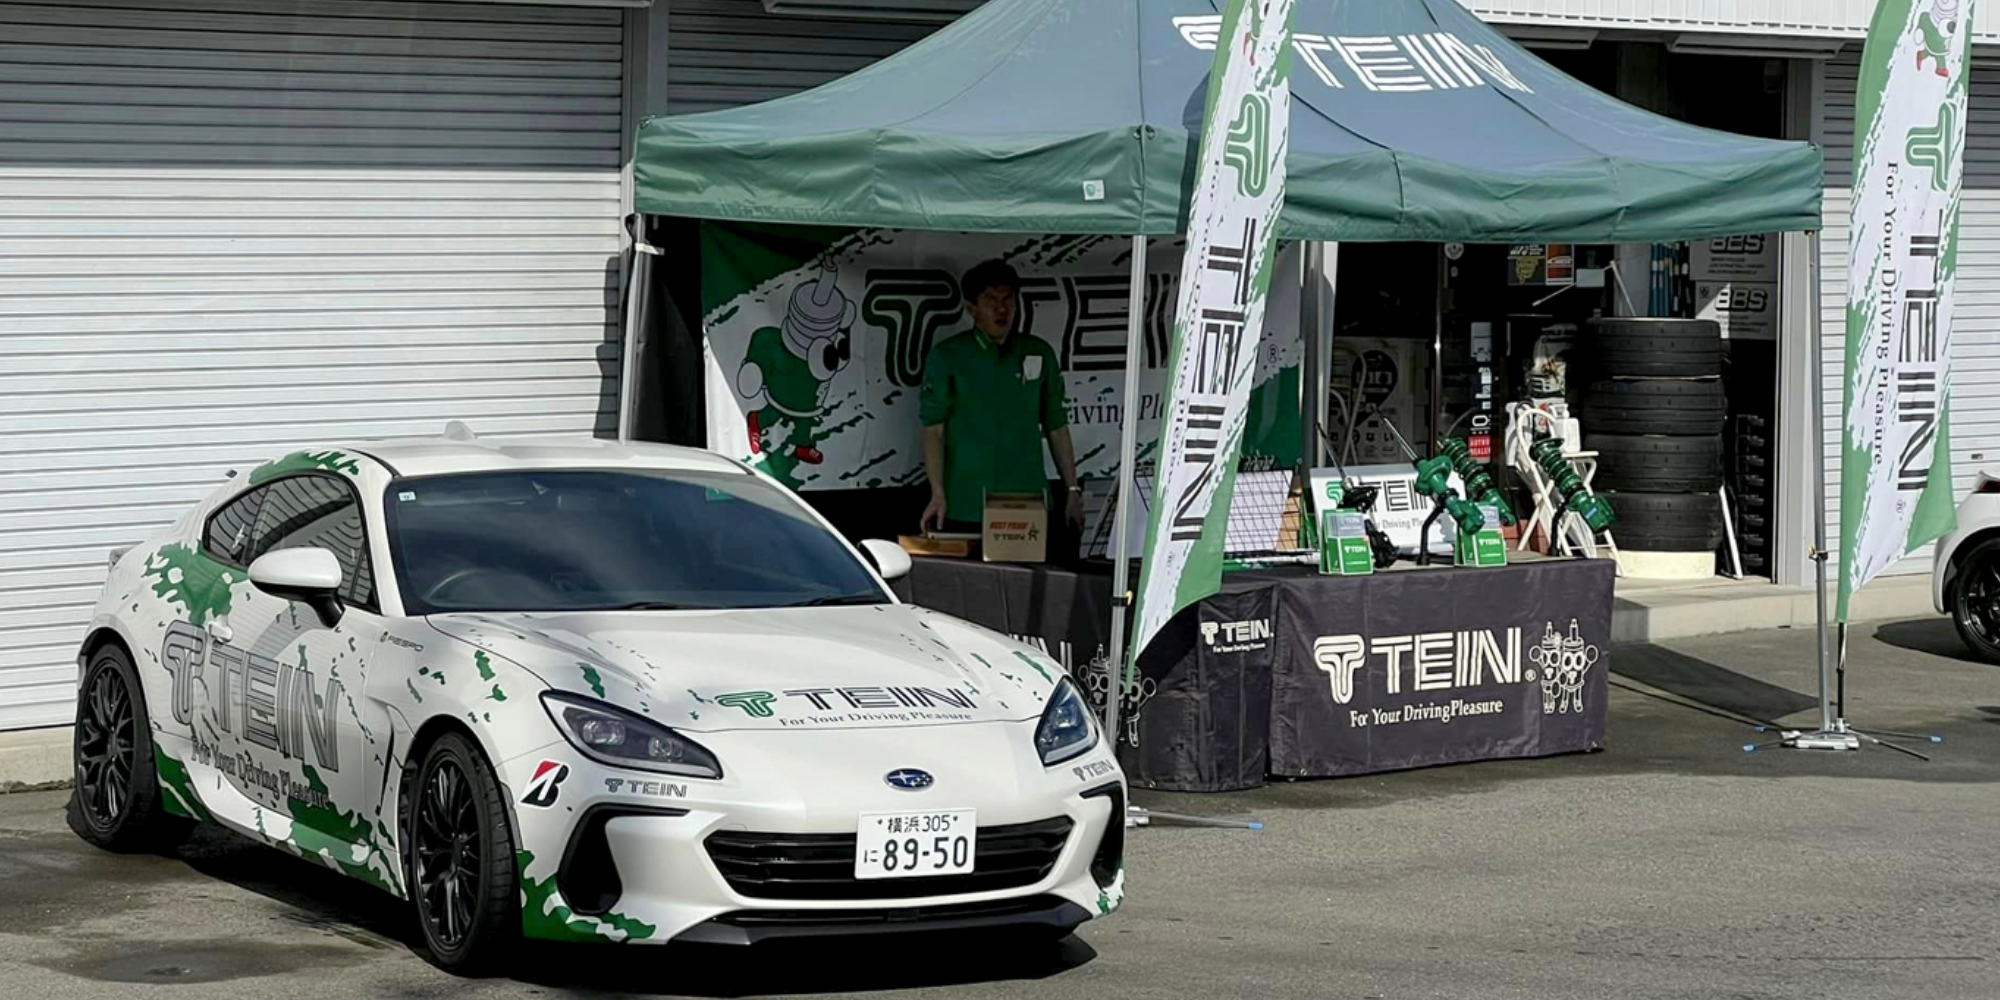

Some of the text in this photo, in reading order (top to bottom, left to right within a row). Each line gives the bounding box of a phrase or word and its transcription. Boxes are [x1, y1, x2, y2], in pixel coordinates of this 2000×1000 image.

[1291, 31, 1535, 94] TEIN
[1715, 287, 1768, 313] BBS
[1871, 161, 1899, 466] For Your Driving Pleasure
[1897, 208, 1943, 491] TEIN
[1171, 217, 1258, 542] TEIN
[1221, 618, 1270, 643] TEIN
[1371, 627, 1522, 694] TEIN
[209, 638, 343, 774] TEIN
[782, 686, 979, 711] TEIN
[1350, 699, 1503, 727] For Your Driving Pleasure
[779, 710, 973, 726] For Your Driving Pleasure
[627, 779, 688, 798] TEIN
[882, 835, 969, 872] 89-50
